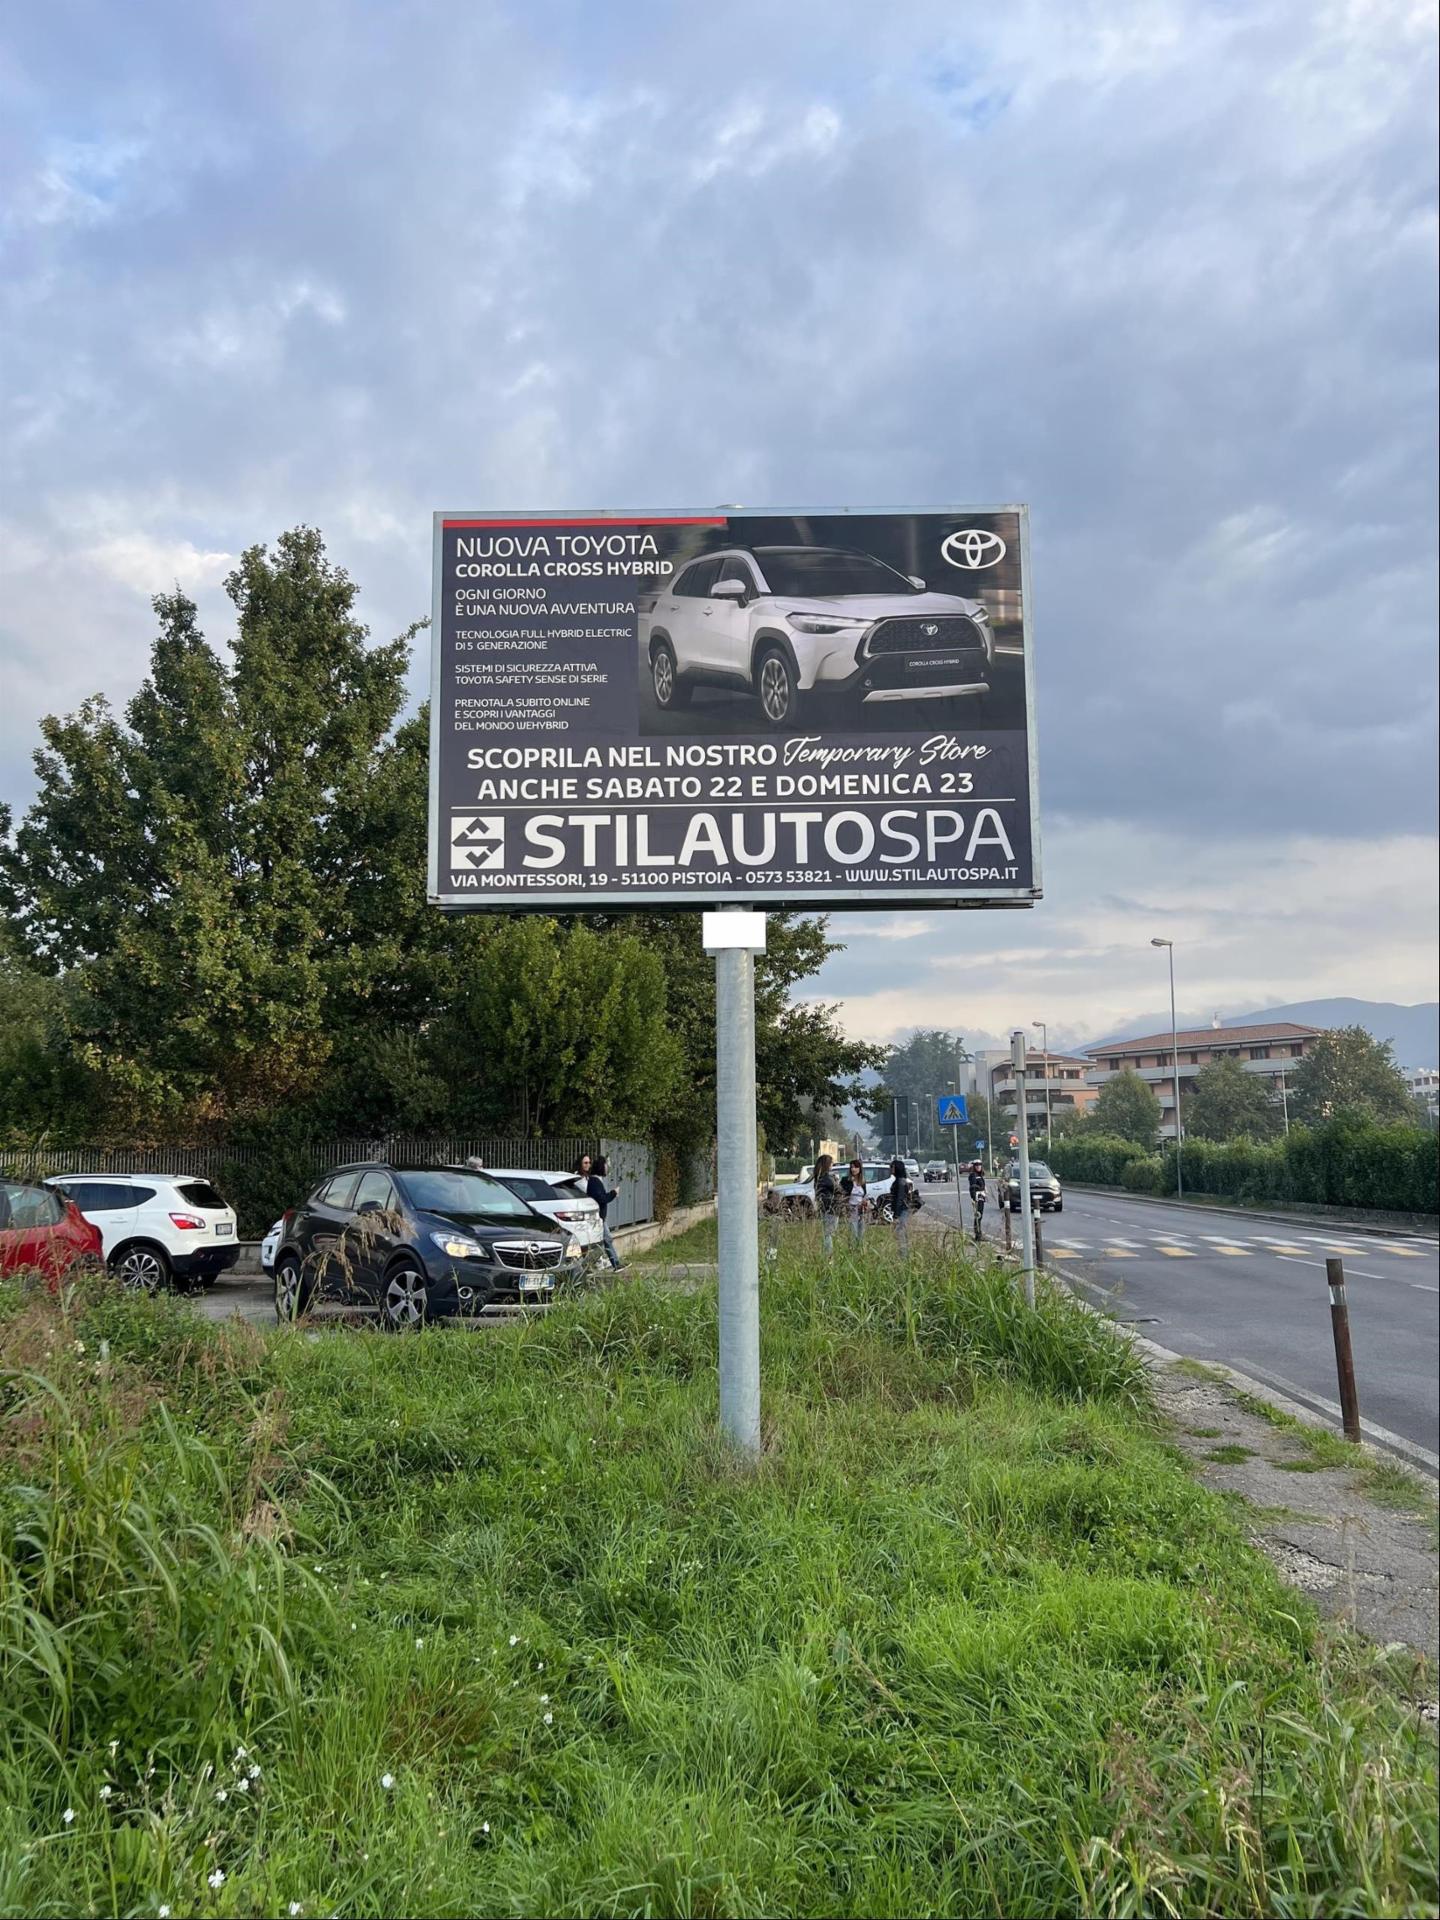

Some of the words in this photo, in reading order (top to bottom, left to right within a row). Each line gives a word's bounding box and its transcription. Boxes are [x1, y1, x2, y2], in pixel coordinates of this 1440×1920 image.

[456, 536, 551, 558] NUOVA
[555, 534, 659, 557] TOYOTA
[455, 562, 541, 578] COROLLA
[543, 562, 604, 577] CROSS
[607, 560, 673, 576] HYBRID
[455, 588, 490, 600] OGNI
[492, 588, 546, 600] GIORNO
[455, 602, 464, 616] È
[466, 604, 496, 616] UNA
[498, 603, 548, 615] NUOVA
[550, 602, 636, 615] AVVENTURA
[455, 630, 520, 639] TECNOLOGIA
[520, 629, 546, 639] FULL
[547, 629, 584, 638] HYBRID
[585, 628, 632, 638] ELECTRIC
[455, 641, 466, 651] DI
[467, 641, 474, 651] 5
[476, 640, 548, 650] GENERAZIONE
[455, 664, 493, 673] SISTEMI
[494, 664, 505, 673] DI
[506, 663, 562, 673] SICUREZZA
[562, 663, 598, 672] ATTIVA
[455, 675, 494, 685] TOYOTA
[495, 675, 533, 684] SAFETY
[535, 675, 567, 684] SENSE
[568, 675, 579, 683] DI
[580, 674, 609, 683] SERIE
[454, 698, 514, 708] PRENOTALA
[515, 698, 551, 707] SUBITO
[552, 697, 590, 707] ONLINE
[454, 710, 461, 719] E
[463, 710, 499, 719] SCOPRI
[500, 710, 503, 718] I
[504, 709, 556, 718] VANTAGGI
[454, 722, 474, 731] DEL
[476, 721, 515, 730] MONDO
[516, 721, 569, 730] WEHYBRID
[467, 747, 603, 770] SCOPRILA
[608, 746, 661, 768] NEL
[667, 744, 777, 767] NOSTRO
[783, 735, 915, 770] Temporary
[919, 734, 992, 766] Store
[477, 778, 578, 801] ANCHE
[586, 776, 702, 799] SABATO
[709, 777, 743, 798] 22
[751, 775, 767, 797] E
[776, 772, 933, 797] DOMENICA
[939, 772, 975, 794] 23
[450, 874, 479, 888] VIA
[481, 873, 587, 888] MONTESSORI,
[589, 873, 608, 886] 19
[621, 872, 669, 886] 51100
[671, 871, 733, 885] PISTOIA
[745, 870, 783, 884] 0573
[785, 869, 832, 884] 53821
[845, 866, 1019, 882] WWW.STILAUTOSPA.IT
